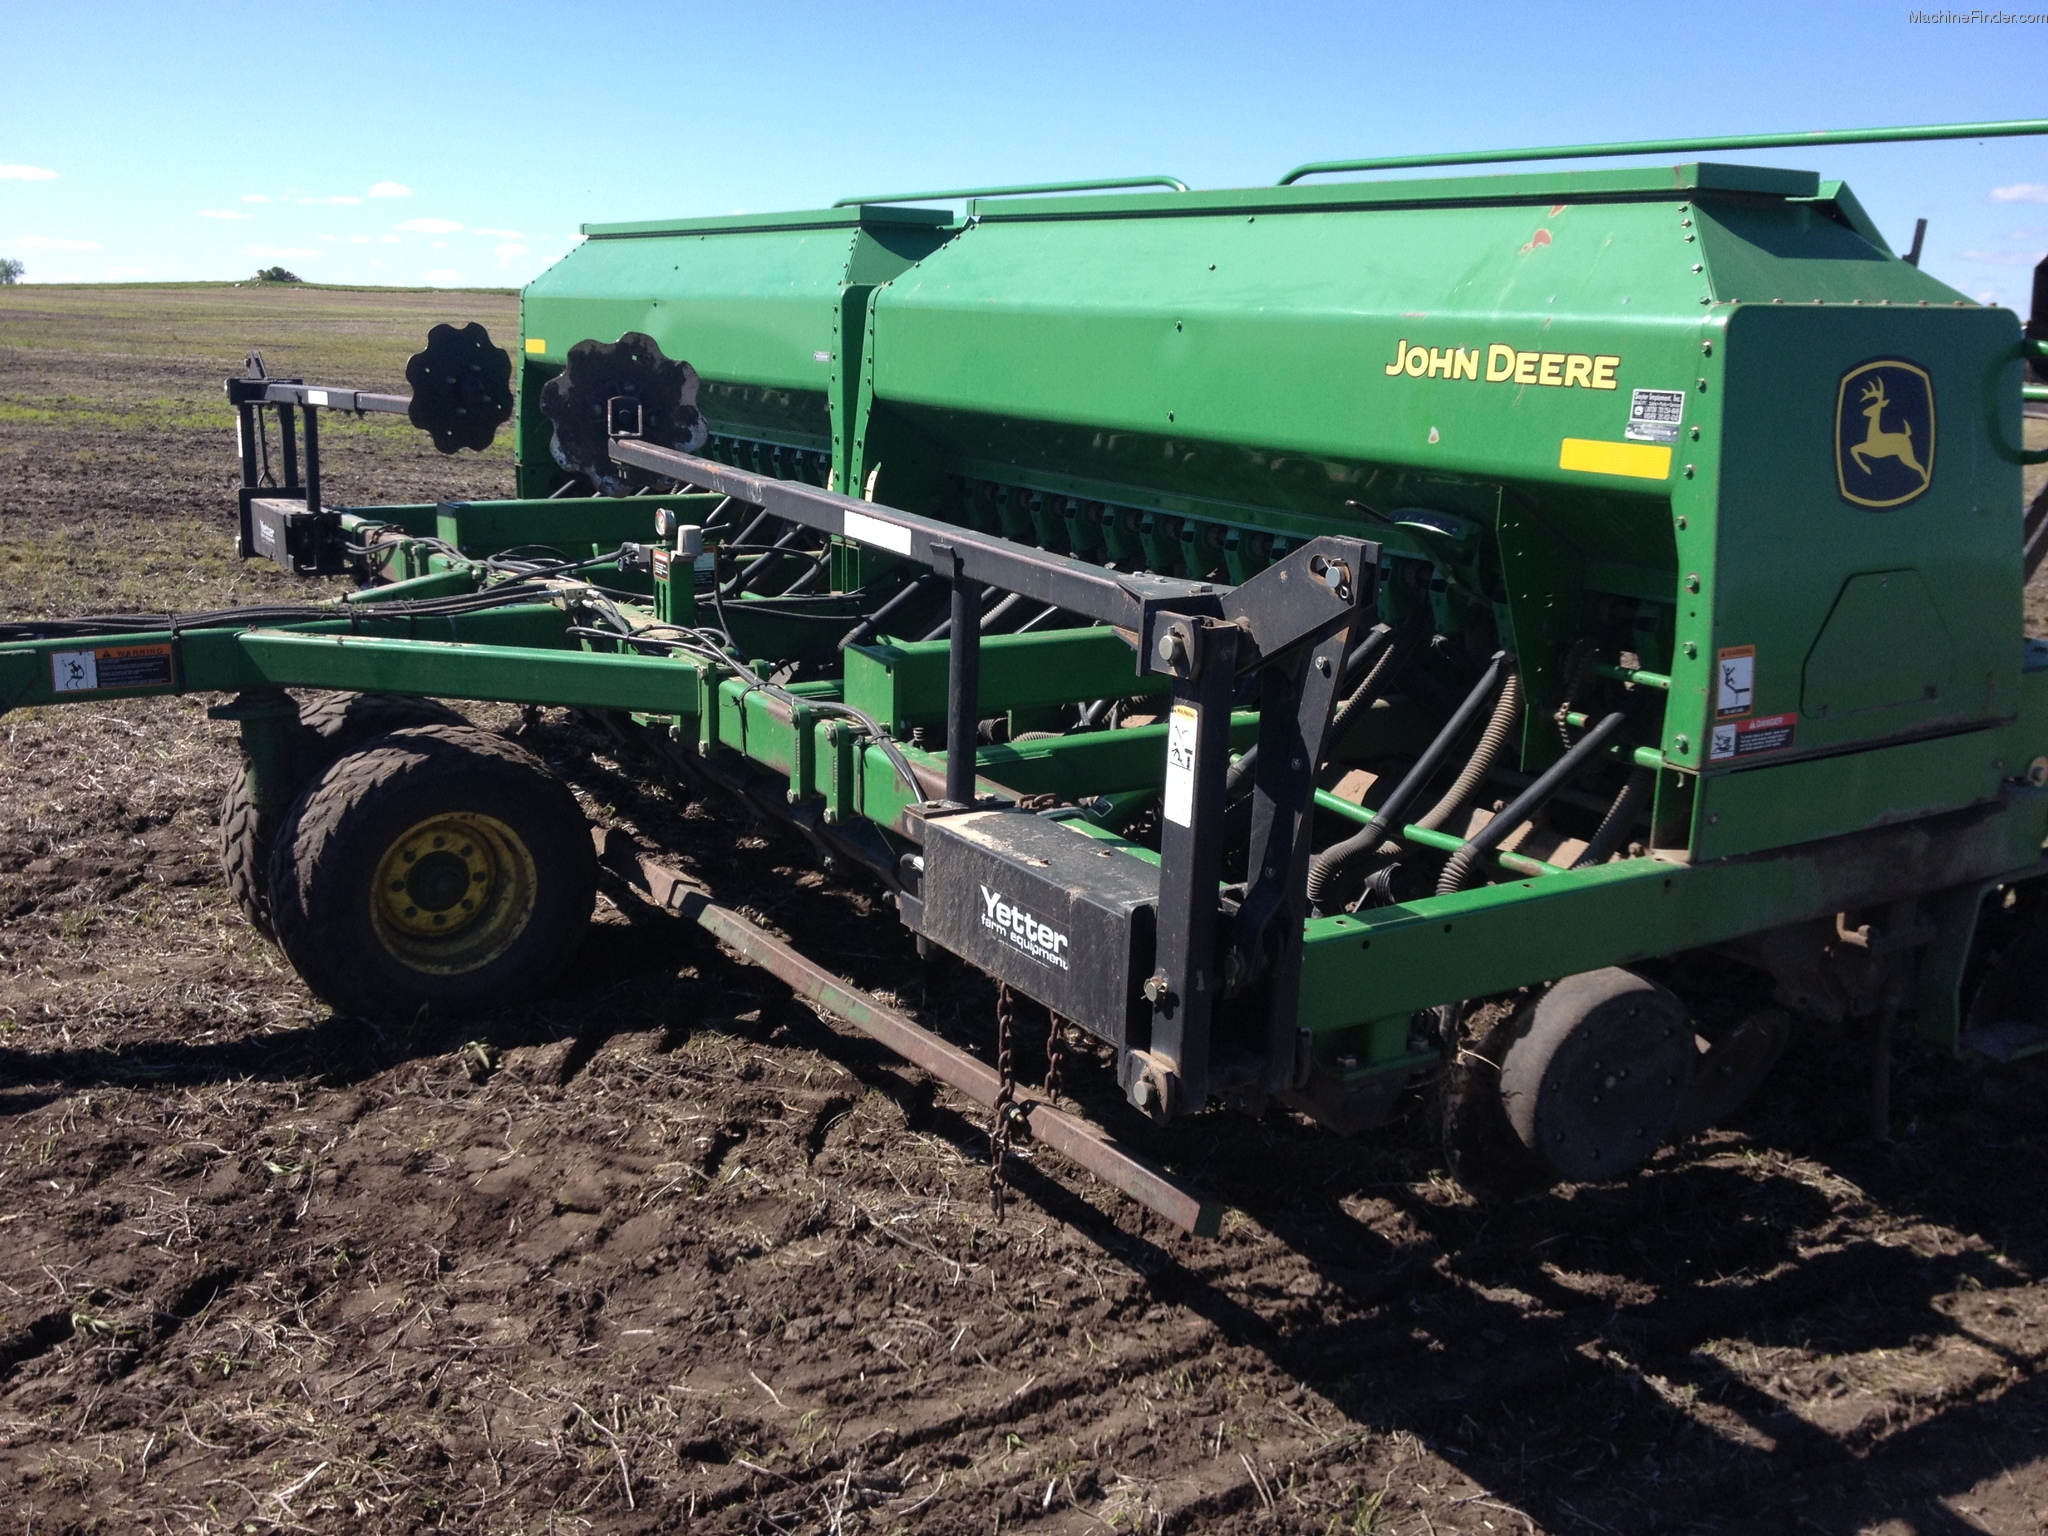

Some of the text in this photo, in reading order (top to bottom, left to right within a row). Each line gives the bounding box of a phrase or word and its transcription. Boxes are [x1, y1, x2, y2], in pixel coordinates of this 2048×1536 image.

[1385, 339, 1620, 390] JOHN DEERE
[117, 648, 164, 656] WARNING
[1756, 717, 1783, 728] DANGER
[980, 884, 1068, 953] Yetter
[981, 914, 1007, 937] farm
[1010, 929, 1069, 971] equipment
